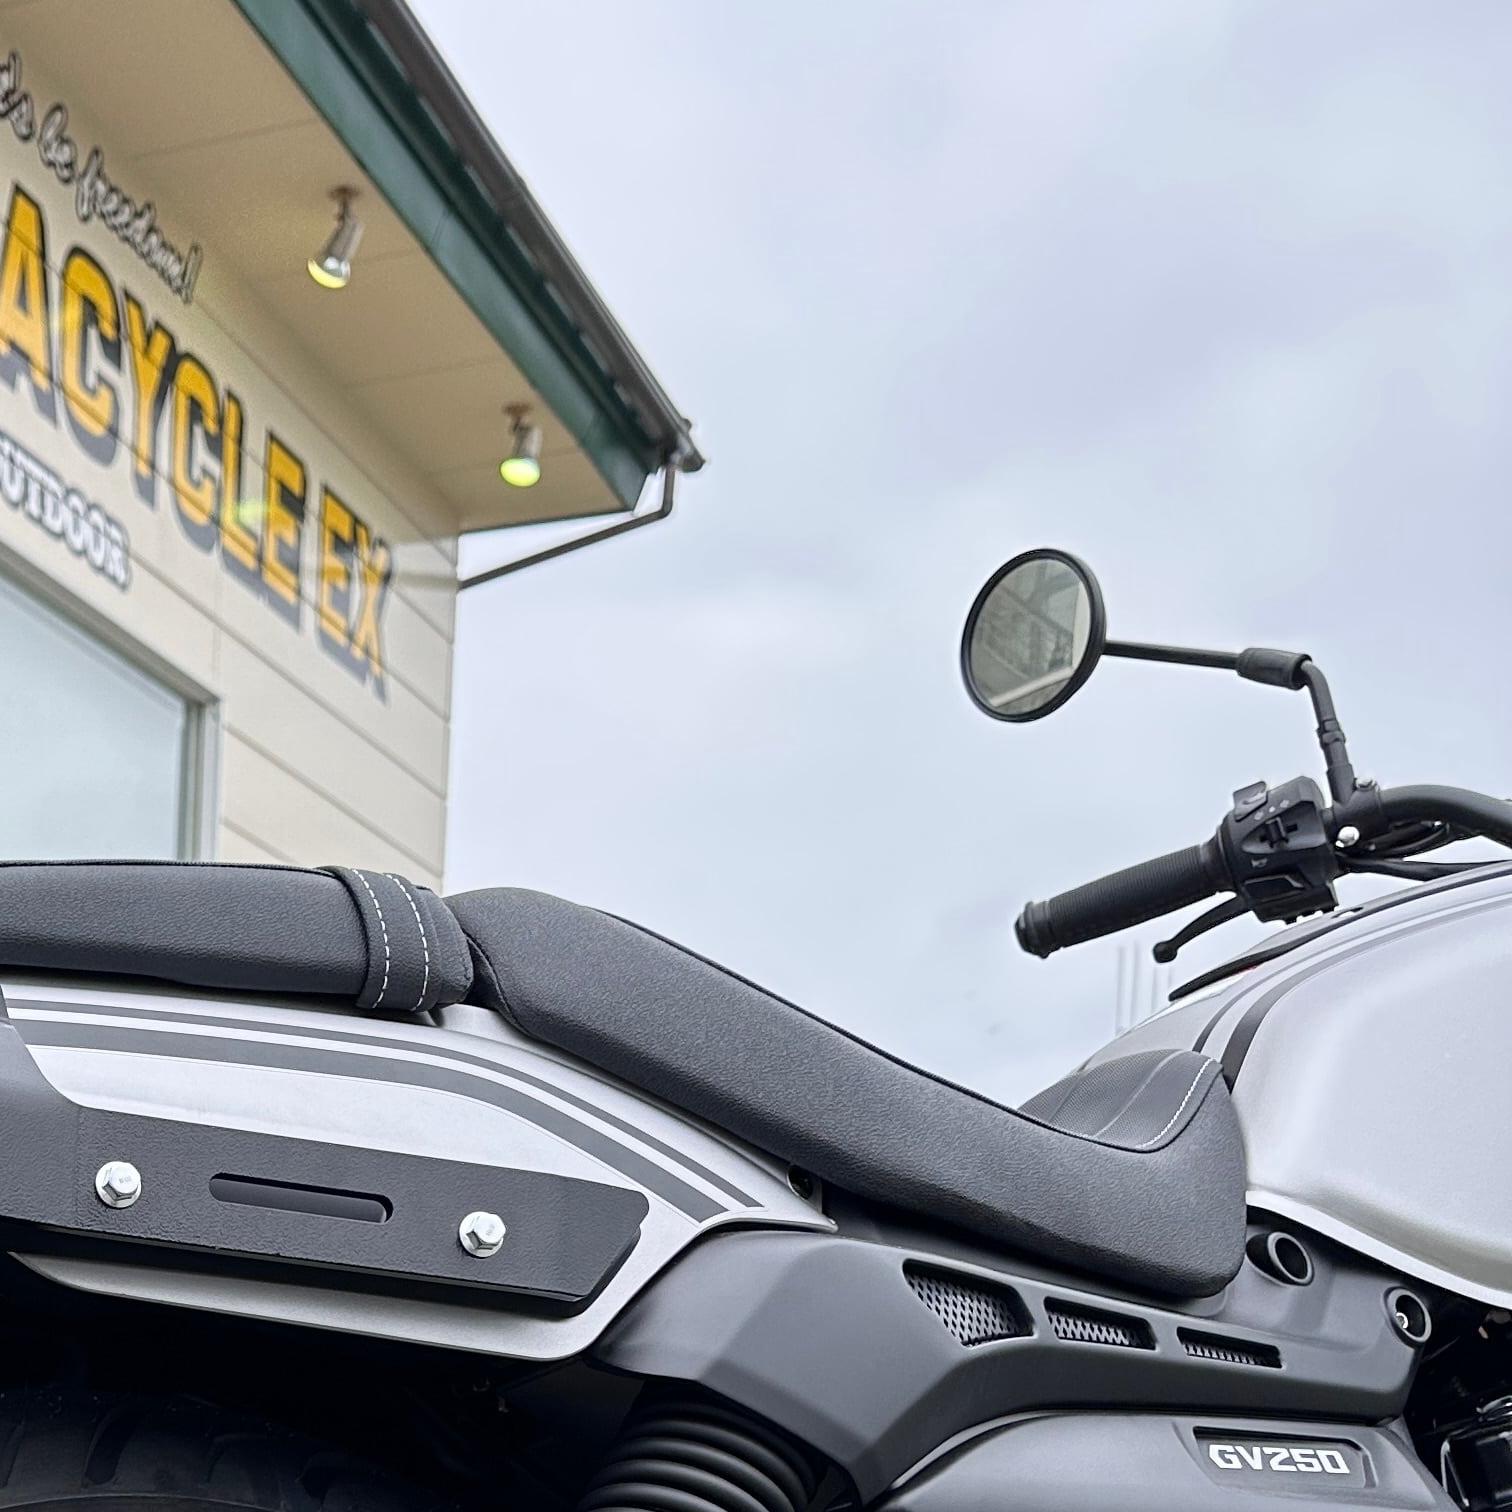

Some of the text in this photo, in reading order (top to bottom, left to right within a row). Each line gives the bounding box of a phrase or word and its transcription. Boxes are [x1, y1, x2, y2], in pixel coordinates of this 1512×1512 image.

[39, 103, 77, 184] be
[318, 484, 392, 690] EX
[1209, 1444, 1350, 1474] GV250
